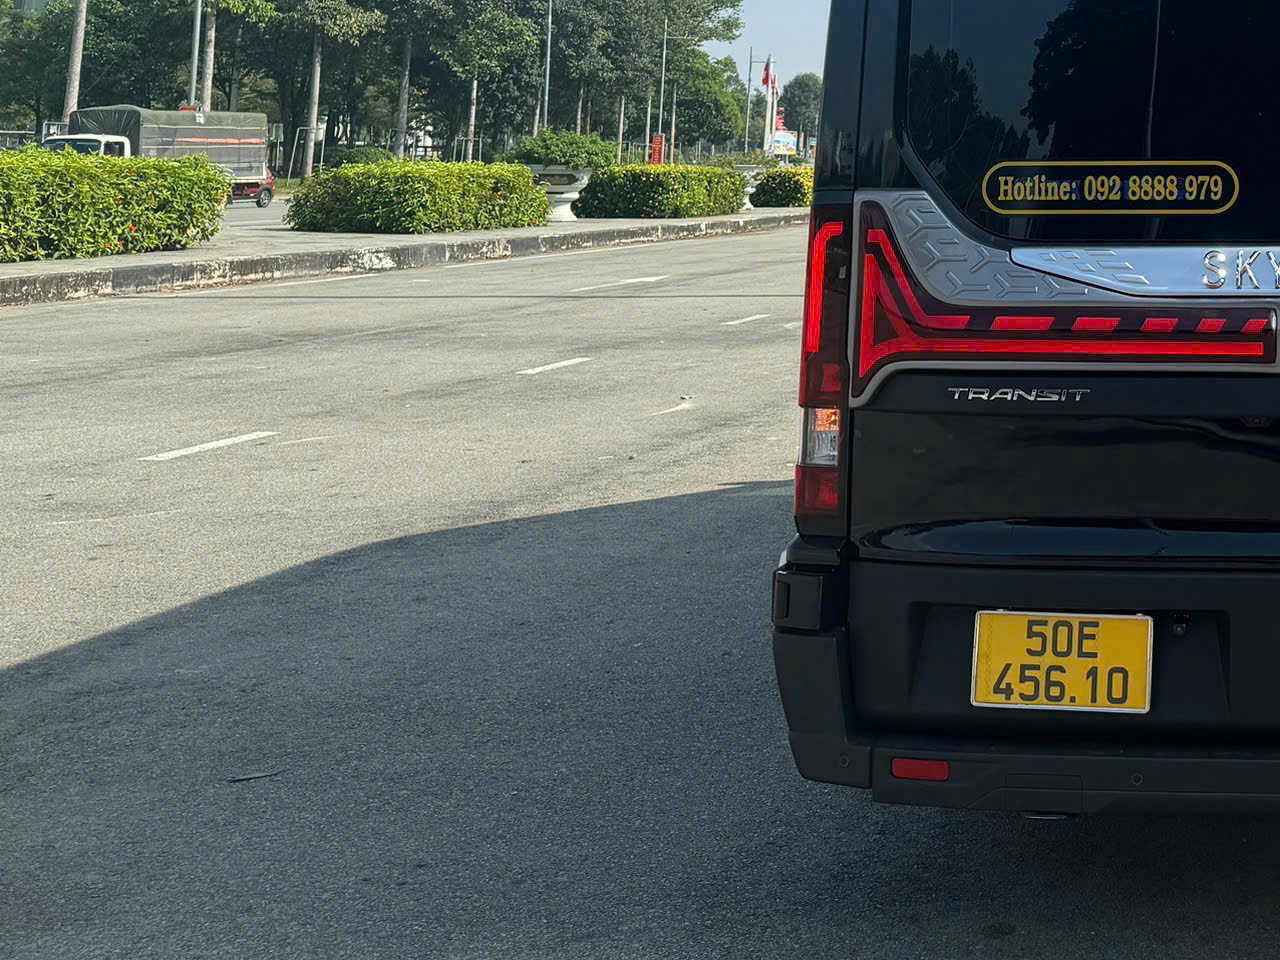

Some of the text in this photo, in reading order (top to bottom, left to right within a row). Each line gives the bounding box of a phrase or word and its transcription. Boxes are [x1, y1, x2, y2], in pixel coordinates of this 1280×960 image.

[998, 174, 1222, 201] Hotline: 092 8888 979
[947, 387, 1091, 401] TRANSIT
[1025, 619, 1100, 659] 50E
[992, 663, 1129, 705] 456.10
